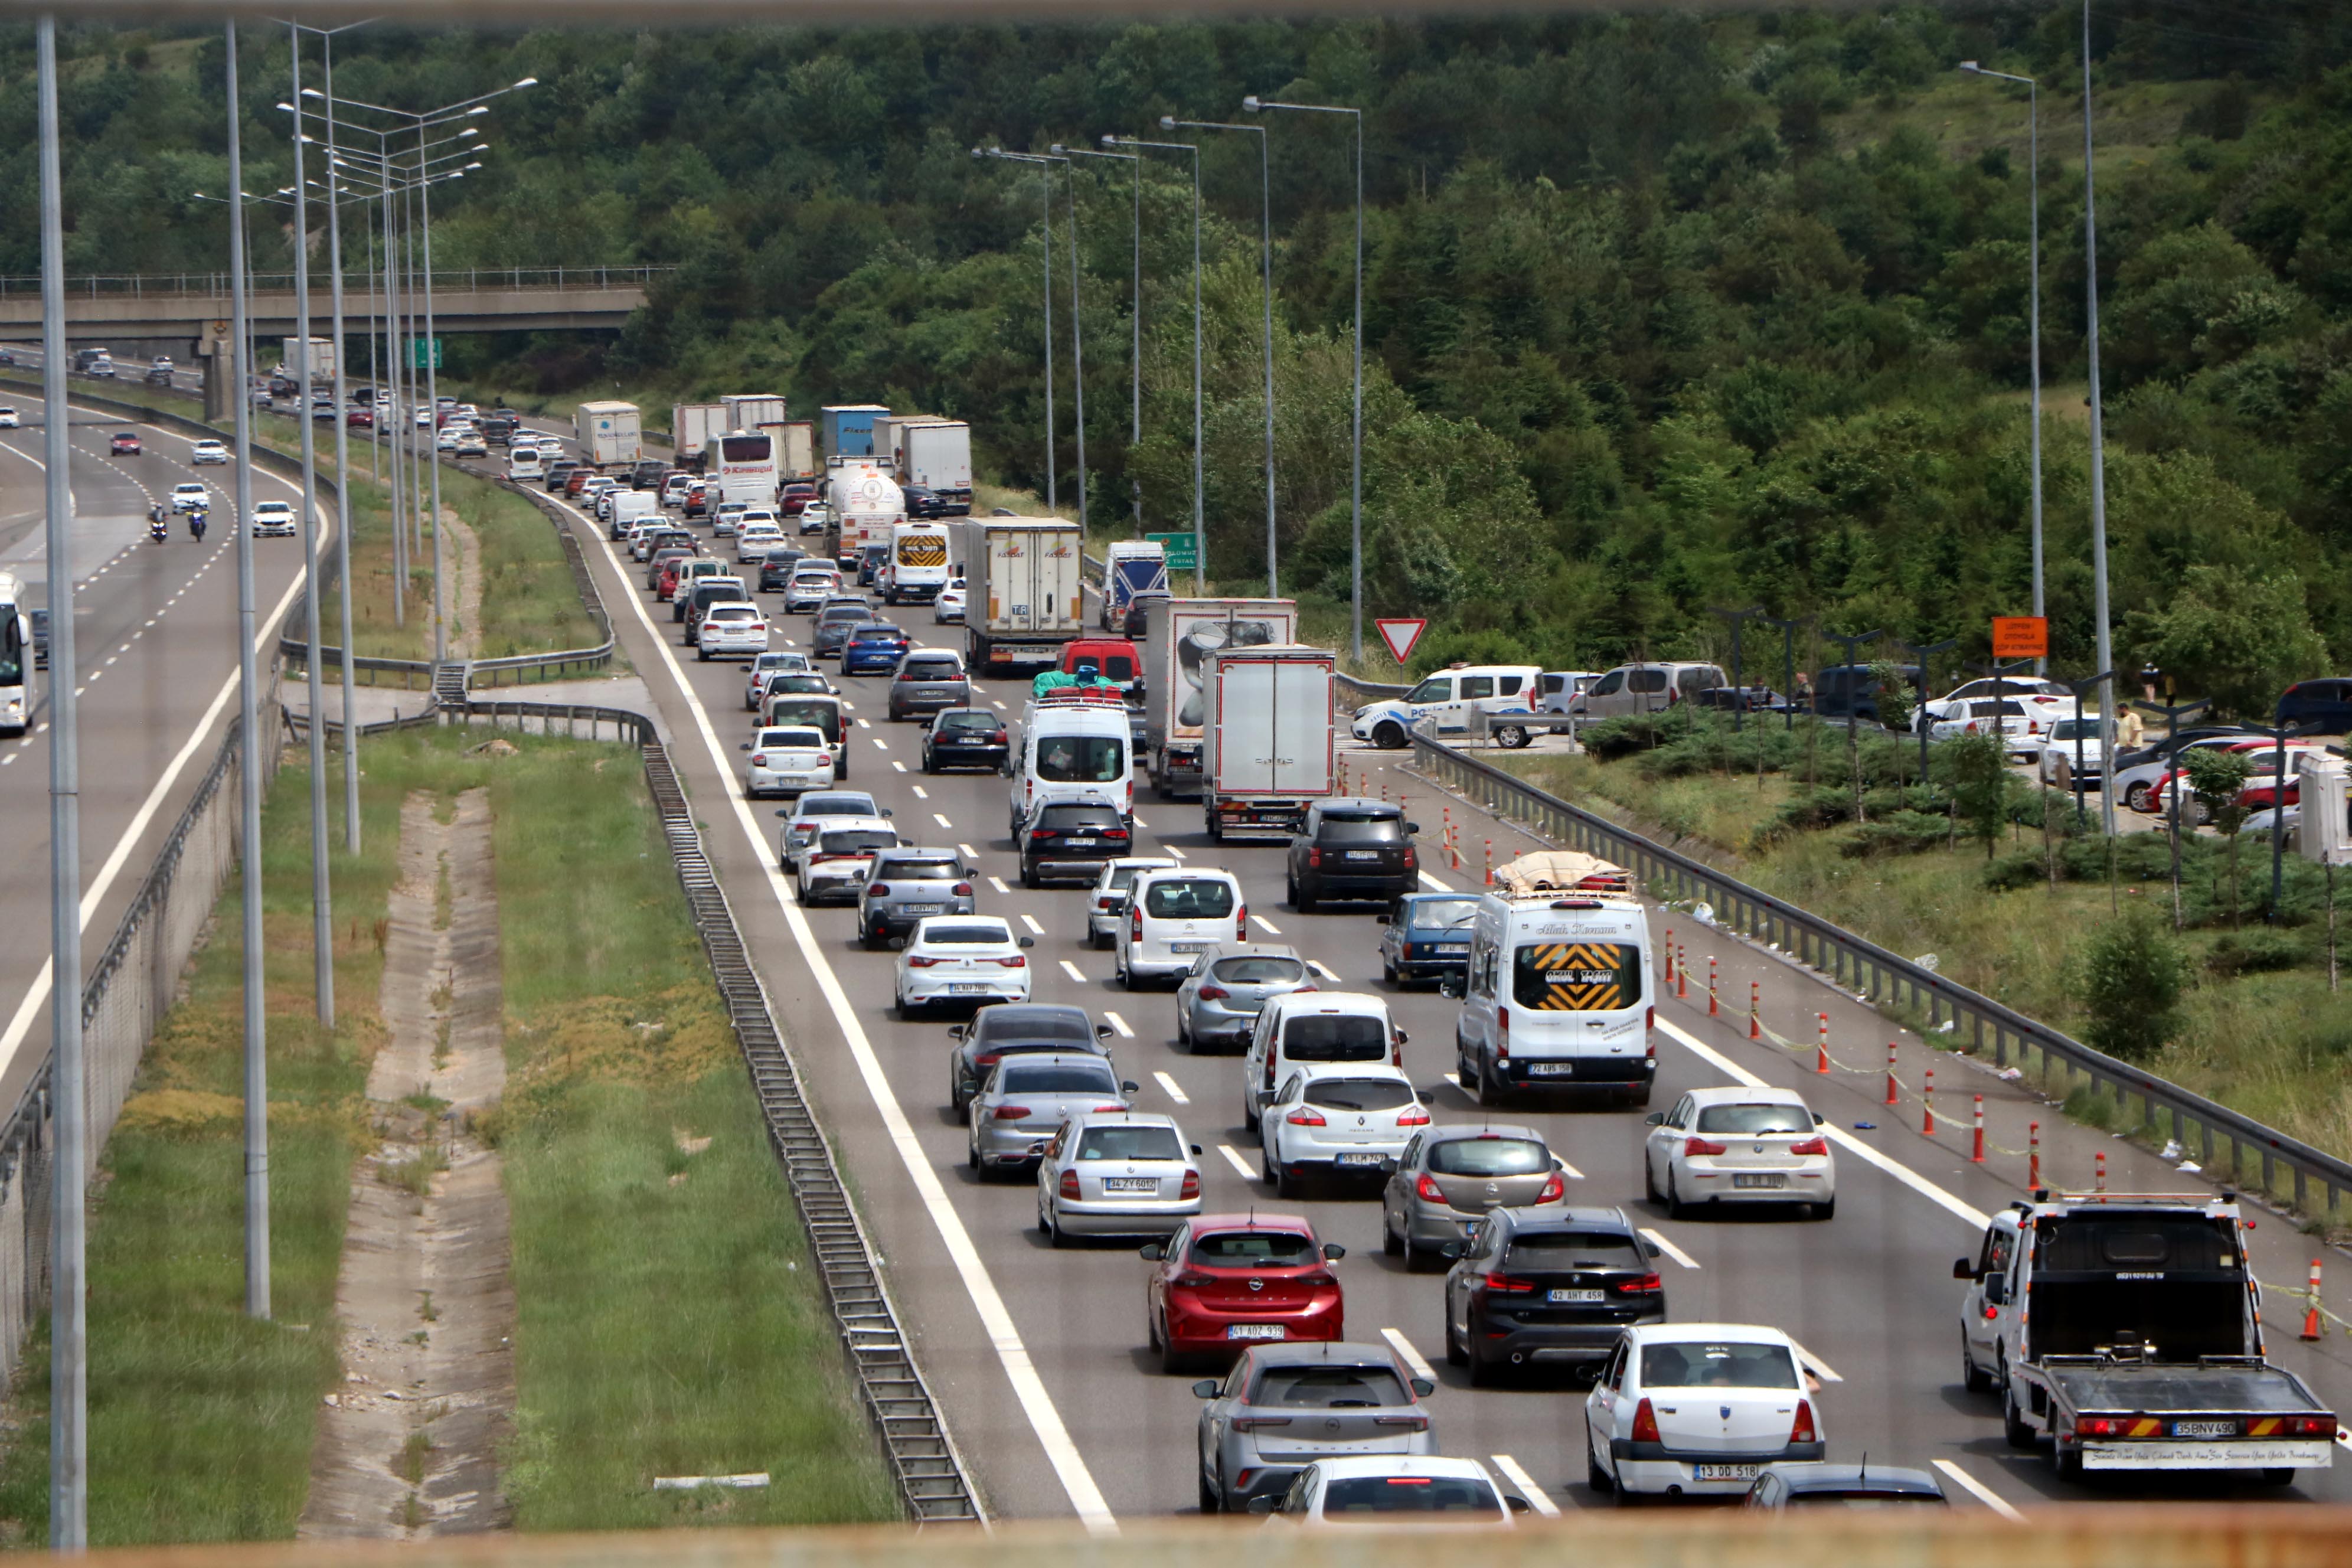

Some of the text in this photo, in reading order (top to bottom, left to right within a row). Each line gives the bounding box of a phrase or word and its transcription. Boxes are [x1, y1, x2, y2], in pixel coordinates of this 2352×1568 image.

[1546, 970, 1574, 983] OKUL
[1553, 1291, 1603, 1300] 42 AHT 458
[1233, 1326, 1242, 1335] 41
[1268, 1326, 1284, 1335] 939
[1701, 1466, 1713, 1476] 13
[1737, 1466, 1756, 1476] 518
